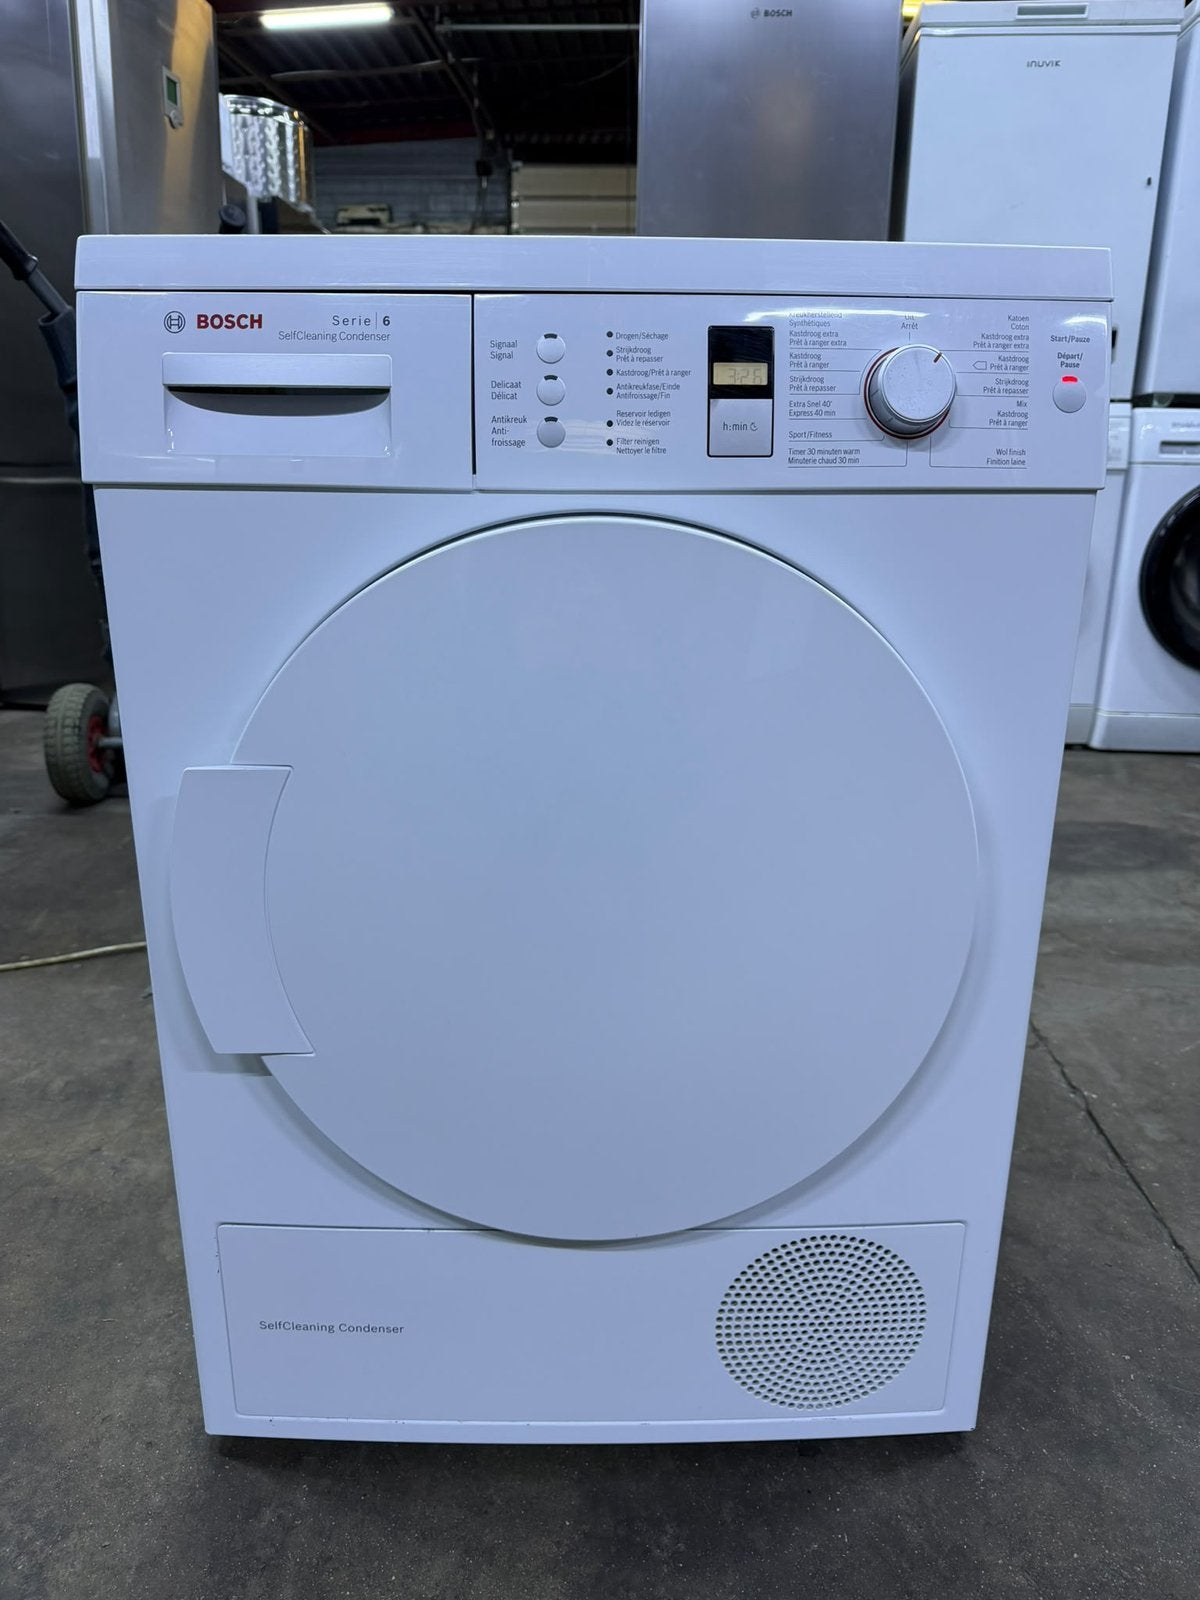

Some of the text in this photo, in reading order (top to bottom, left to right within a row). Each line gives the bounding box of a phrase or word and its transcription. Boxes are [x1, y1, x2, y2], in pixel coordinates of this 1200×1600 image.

[764, 9, 793, 17] BOSCH
[196, 313, 263, 330] BOSCH
[332, 315, 391, 326] Serie 6
[1008, 314, 1030, 322] Katoen
[789, 319, 831, 328] Synthétiques
[901, 321, 919, 330] Arrêt
[1010, 323, 1030, 331] Coton
[278, 330, 391, 342] SelfCleaning Condenser
[615, 331, 669, 341] Drogen/Séchage
[789, 330, 822, 339] Kastdroog
[981, 332, 1013, 341] Kastdroog
[1050, 334, 1091, 344] Start/Pauze
[490, 339, 518, 350] Signaal
[789, 338, 803, 346] Prêt
[808, 340, 830, 348] ranger
[973, 340, 987, 348] Prêt
[615, 346, 652, 355] Strijkdroog
[490, 351, 514, 361] Signal
[630, 355, 635, 363] à
[789, 352, 822, 360] Kastdroog
[998, 355, 1030, 364] Kastdroog
[1057, 351, 1084, 361] Départ/
[789, 361, 803, 369] Prêt
[803, 361, 808, 369] à
[990, 363, 1003, 371] Prêt
[1009, 365, 1029, 373] ranger
[1060, 361, 1081, 369] Pause
[616, 368, 666, 377] Kastdroog/Prêt
[789, 375, 825, 384] Strijkdroog
[995, 377, 1029, 387] Strijkdroog
[491, 380, 522, 389] Delicaat
[616, 382, 681, 391] Antikreukfase/Einde
[789, 384, 803, 392] Prêt
[803, 384, 808, 392] à
[491, 391, 518, 400] Délicat
[983, 386, 997, 394] Prêt
[1002, 388, 1029, 396] repasser
[616, 392, 671, 401] Antifroissage/Fin
[789, 400, 806, 408] Extra
[807, 400, 821, 408] Snel
[1016, 400, 1028, 408] Mix
[616, 410, 671, 419] Reservoir ledigen
[789, 409, 836, 418] Express 40 min
[997, 410, 1029, 419] Kastdroog
[491, 415, 528, 424] Antikreuk
[616, 419, 671, 427] Videz le réservoir
[989, 418, 1028, 428] Prêt à ranger
[491, 426, 510, 435] Anti-
[722, 421, 748, 431] h:min
[788, 431, 833, 440] Sport/Fitness
[491, 438, 526, 448] froissage
[634, 438, 660, 447] reinigen
[616, 447, 667, 456] Nettoyer le filtre
[788, 448, 806, 456] Timer
[807, 448, 816, 456] 30
[816, 448, 842, 456] minuten
[996, 448, 1026, 456] Wol finish
[787, 457, 818, 465] Minuterie
[818, 457, 838, 465] chaud
[986, 457, 1026, 466] Finition laine
[259, 1320, 405, 1334] SelfCleaning Condenser
